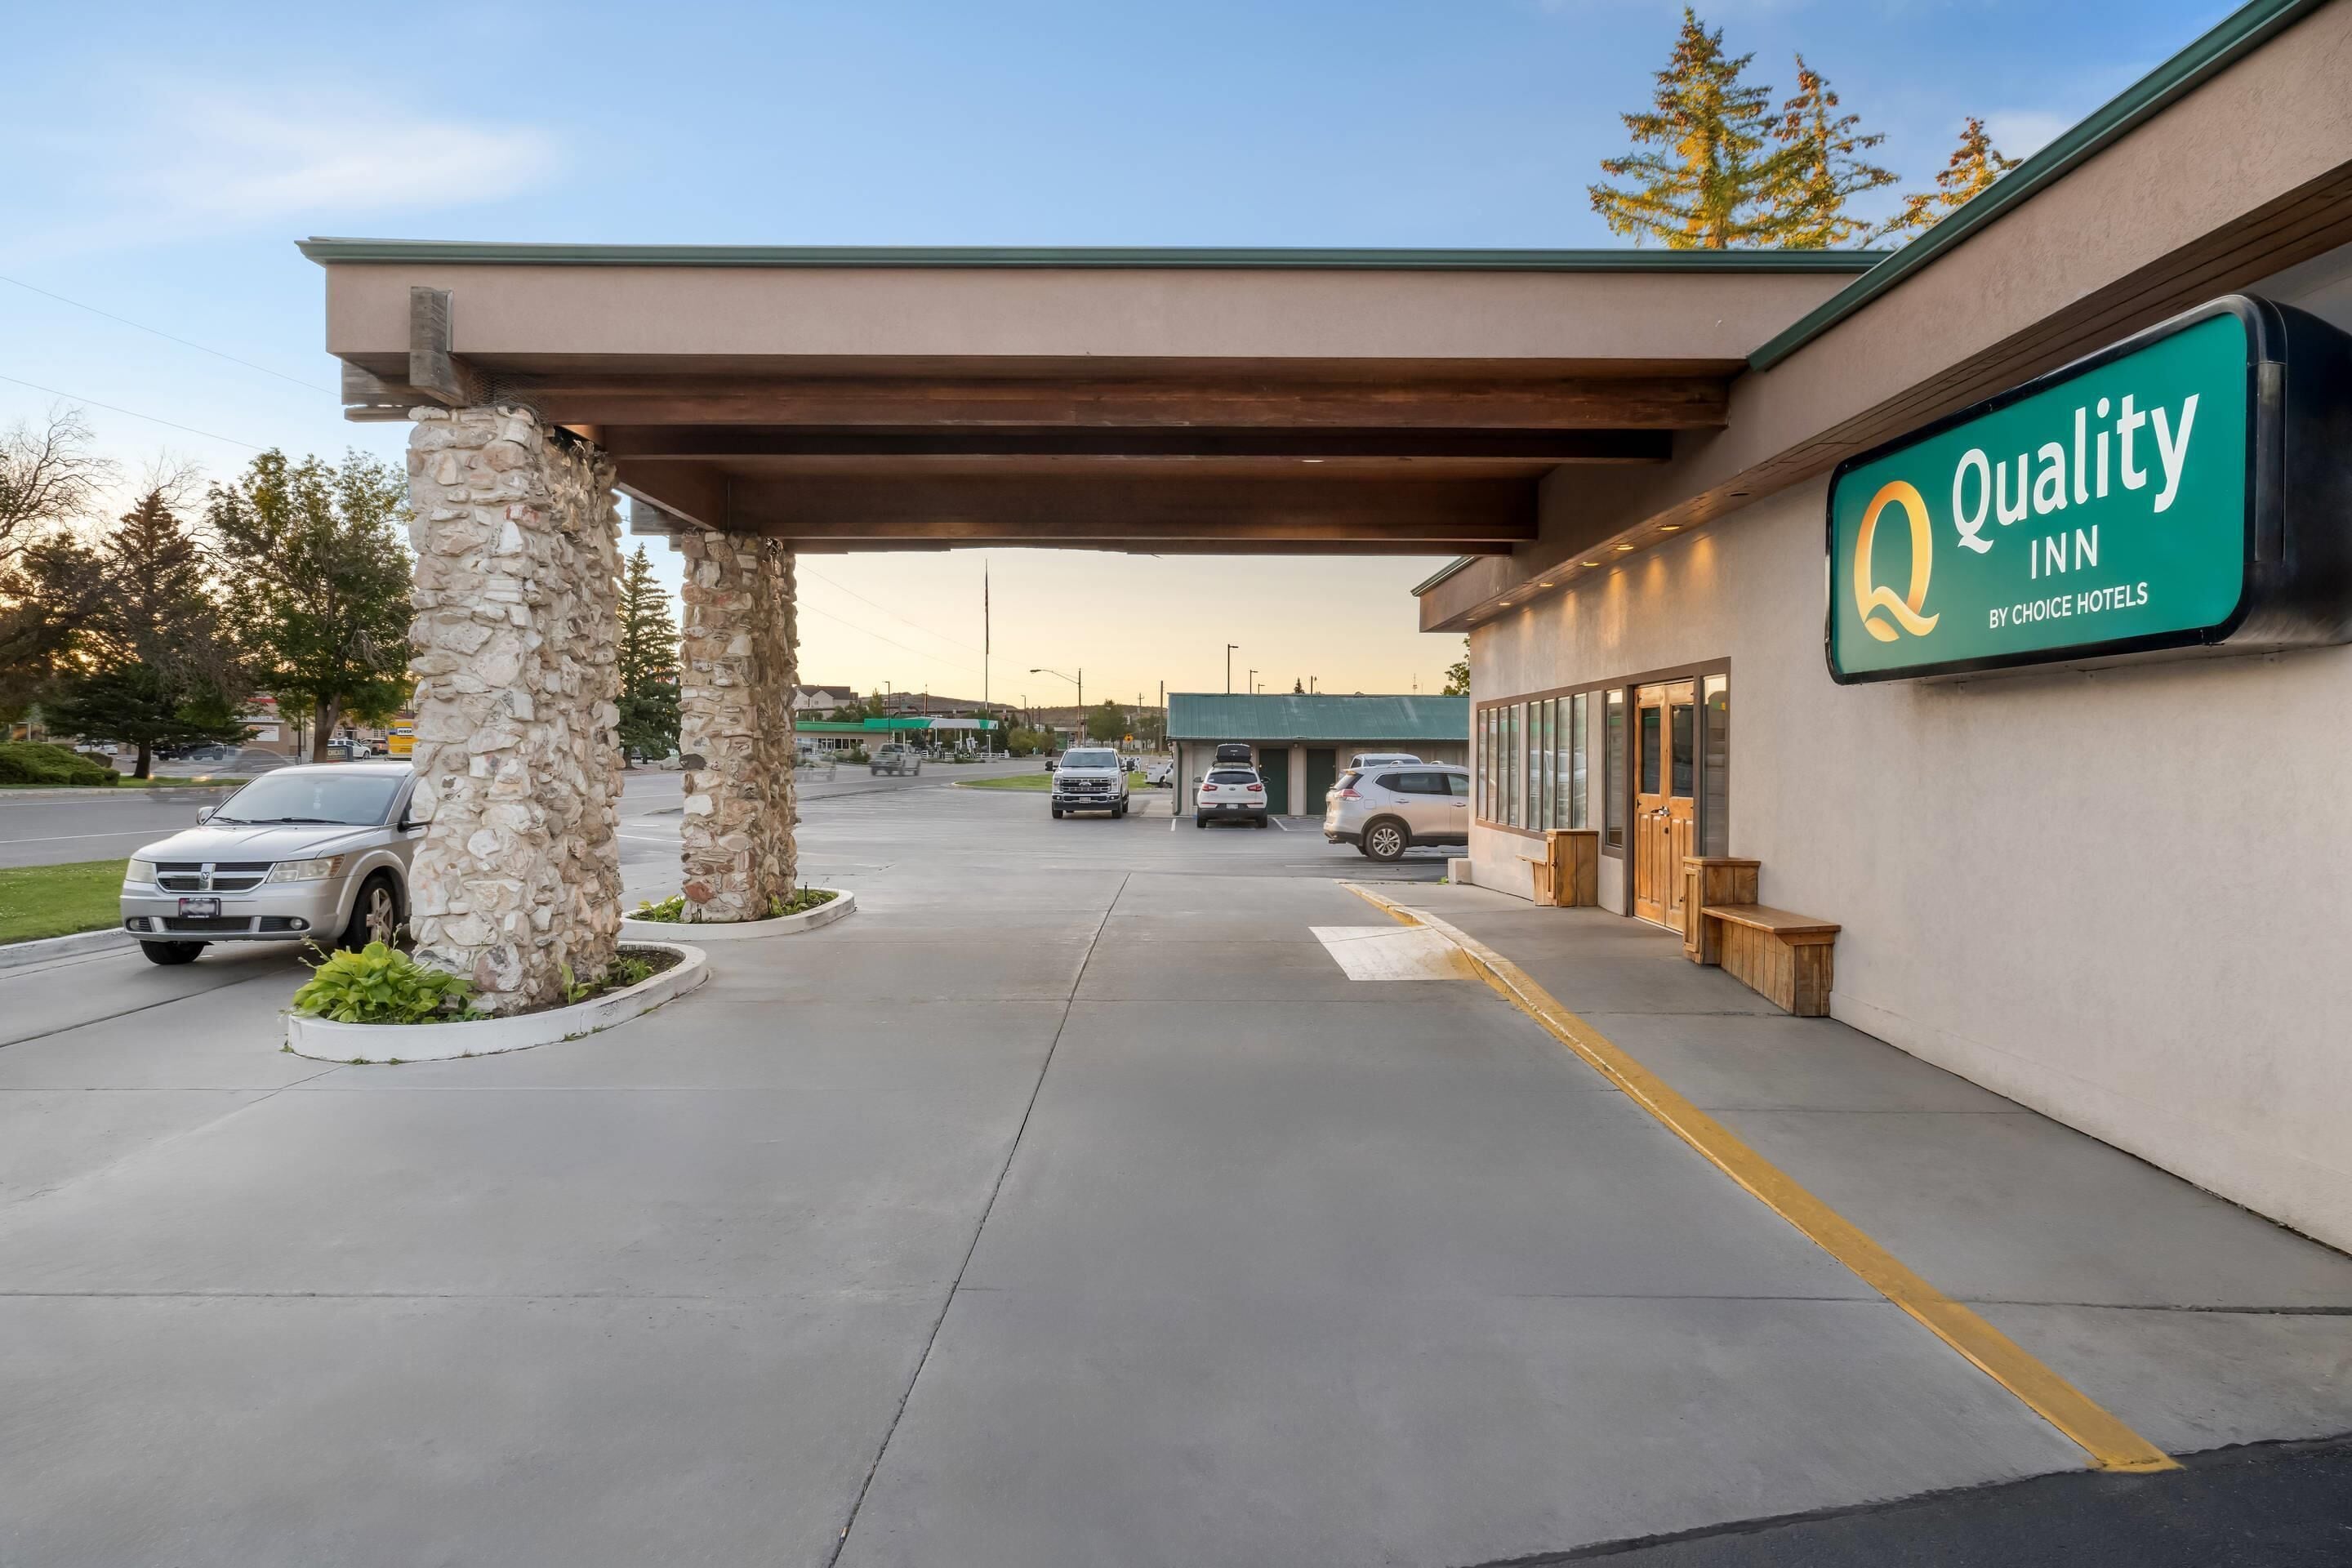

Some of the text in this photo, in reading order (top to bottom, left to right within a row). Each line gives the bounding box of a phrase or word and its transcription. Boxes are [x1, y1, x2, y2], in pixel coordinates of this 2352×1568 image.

[1952, 393, 2200, 555] Quality
[1853, 480, 1940, 642] Q
[1989, 581, 2149, 630] BY CHOICE HOTELS
[2031, 524, 2098, 580] INN
